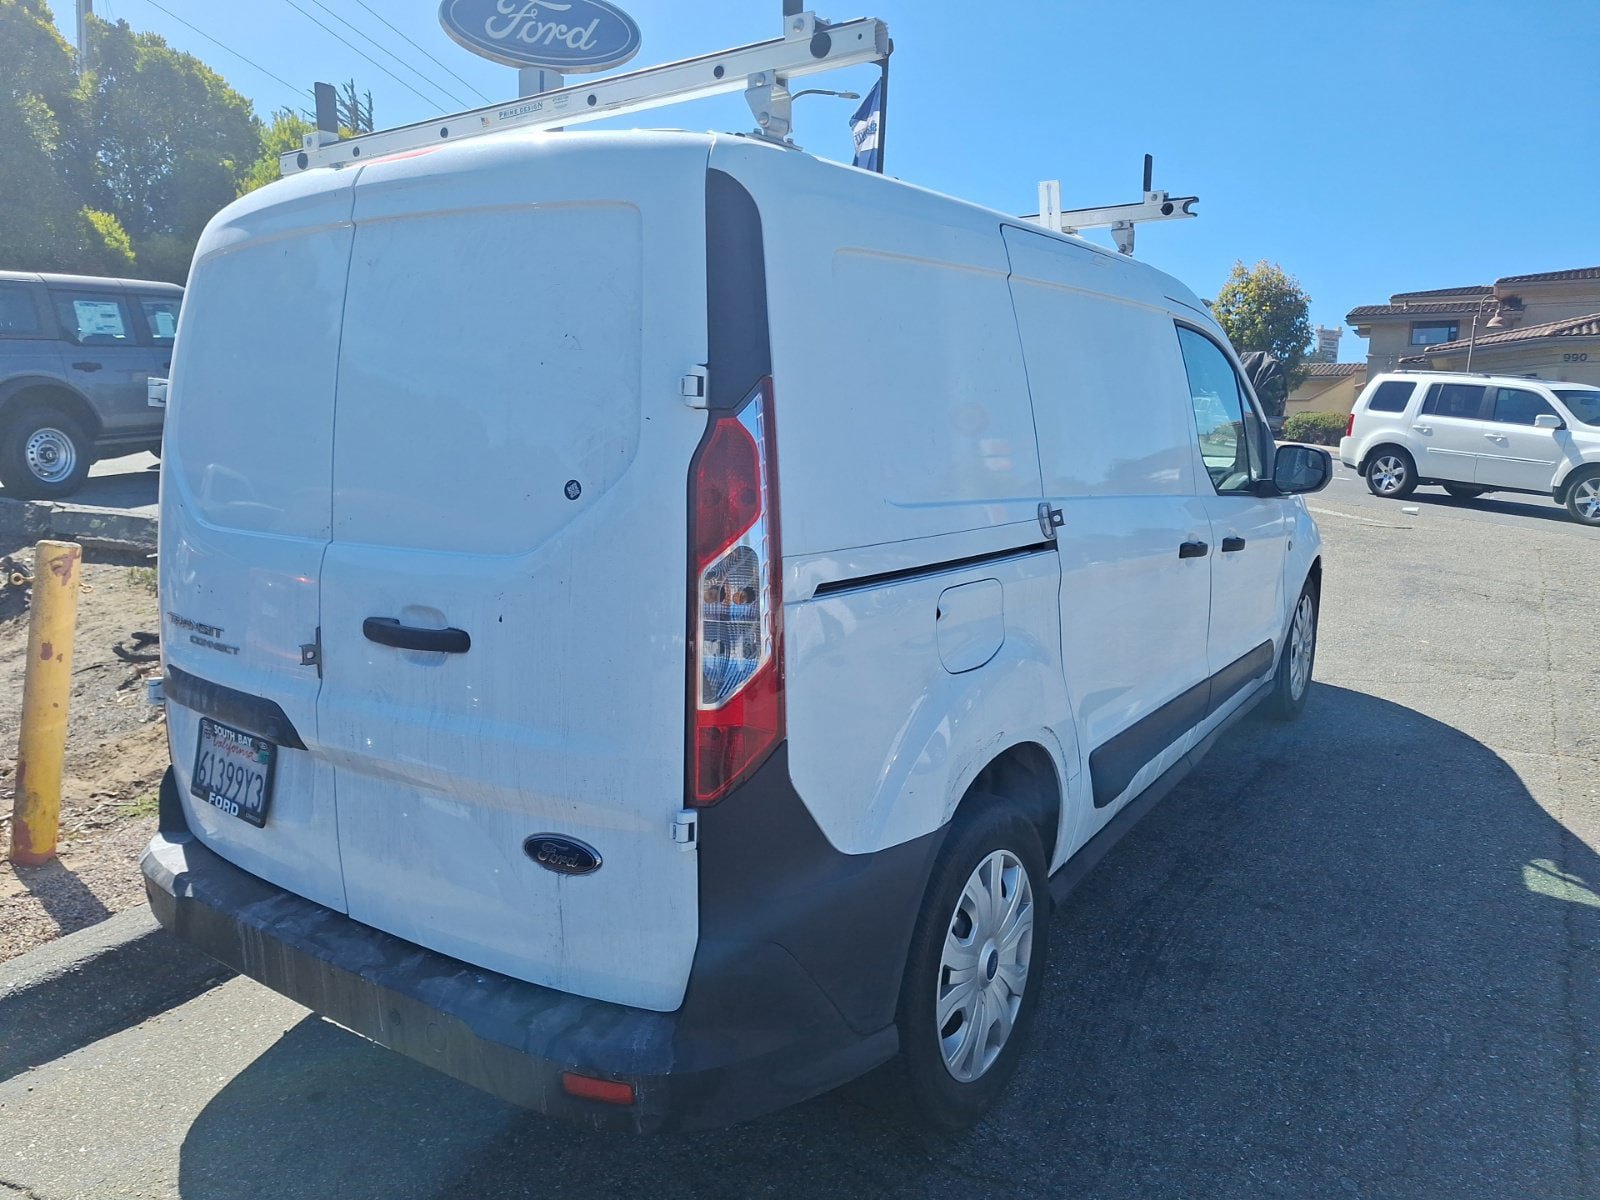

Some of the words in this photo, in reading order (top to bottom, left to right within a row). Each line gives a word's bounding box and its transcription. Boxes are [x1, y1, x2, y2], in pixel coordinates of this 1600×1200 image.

[485, 0, 600, 50] Ford
[499, 107, 518, 119] PRIME
[519, 102, 543, 115] DESIGN
[1563, 352, 1588, 362] 990
[213, 724, 235, 742] SOUTH
[237, 733, 253, 747] BAY
[198, 751, 264, 811] 61399Y3
[208, 791, 239, 816] FORD
[537, 842, 580, 867] Ford
